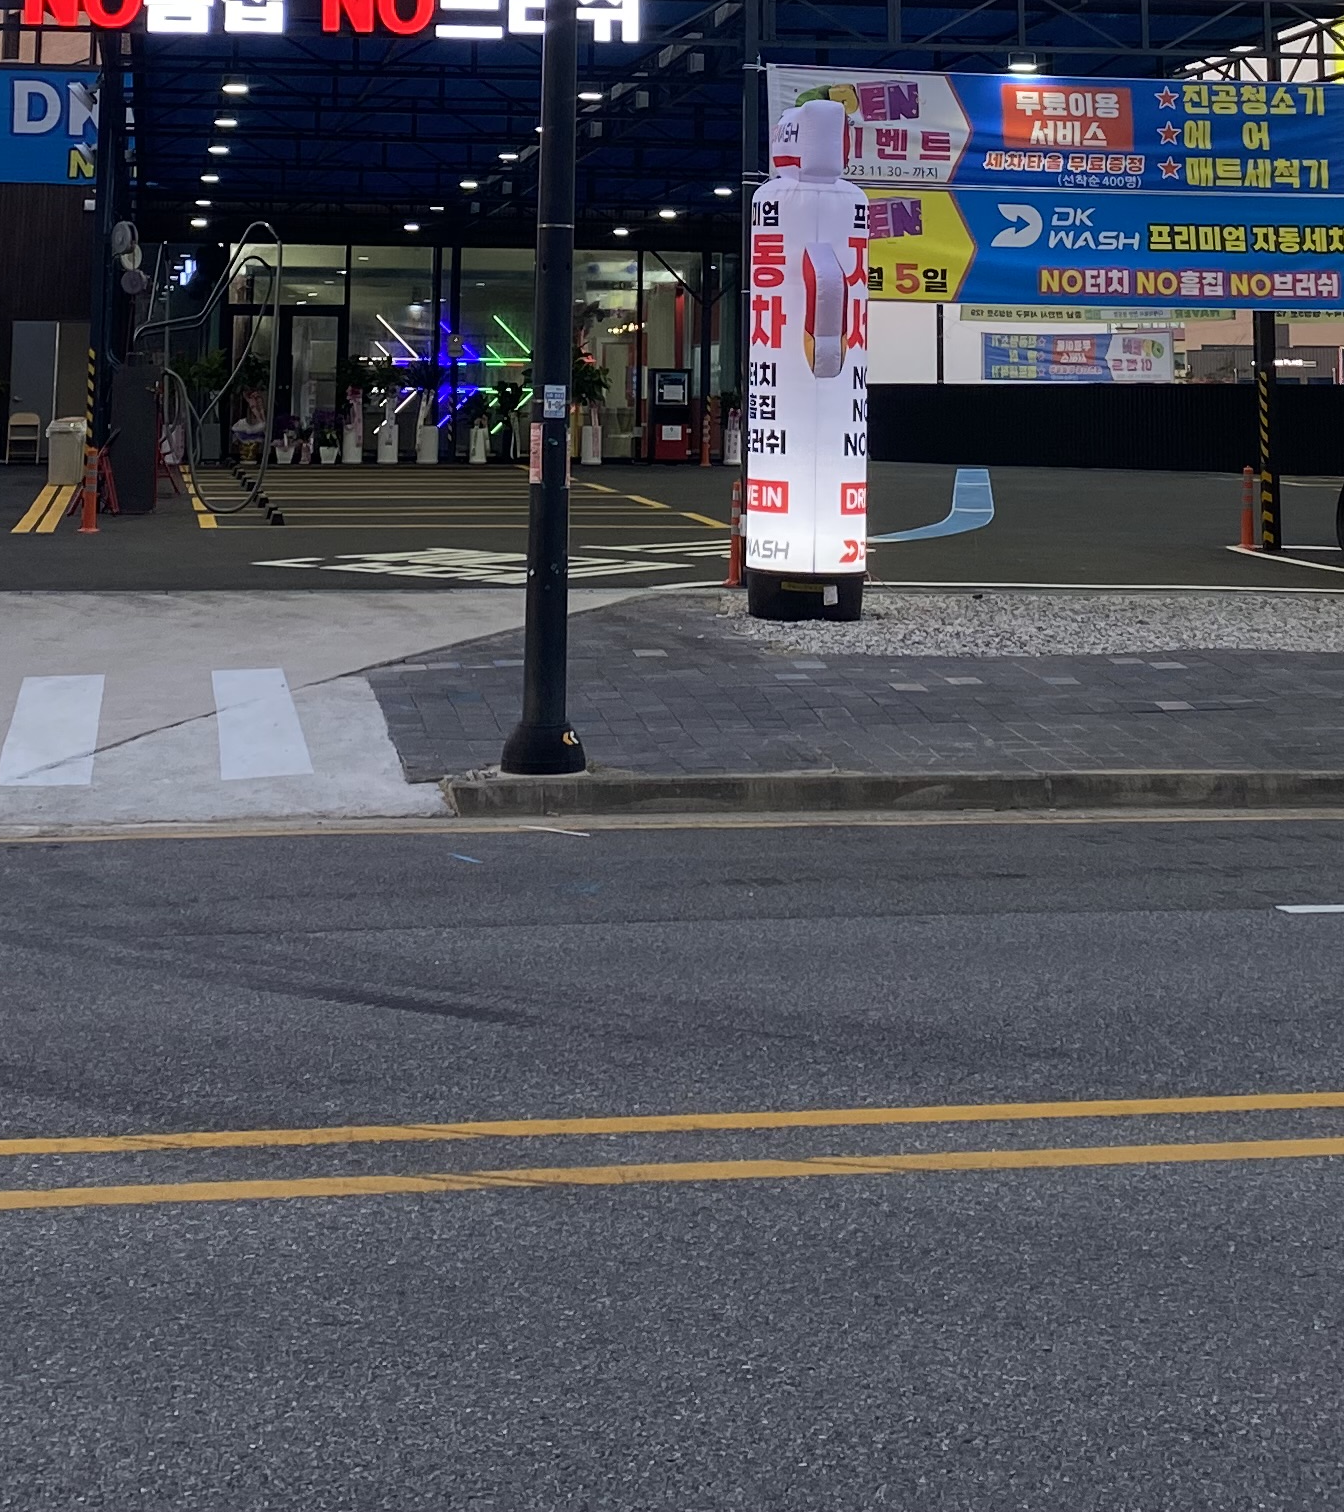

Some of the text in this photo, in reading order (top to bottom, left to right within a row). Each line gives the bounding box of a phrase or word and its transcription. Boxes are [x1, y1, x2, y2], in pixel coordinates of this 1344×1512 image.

[1016, 90, 1120, 118] 무료이용
[1182, 85, 1326, 116] 진공청소기
[1030, 121, 1107, 148] 서비스
[1066, 155, 1146, 175] 무료증정
[1184, 157, 1329, 189] 매트세척기
[1051, 207, 1096, 226] DK
[1048, 231, 1140, 250] WASH
[1148, 225, 1246, 252] 프리미엄
[1040, 270, 1340, 298] NO터치 NO흠집 NO브러쉬
[762, 487, 782, 507] IN
